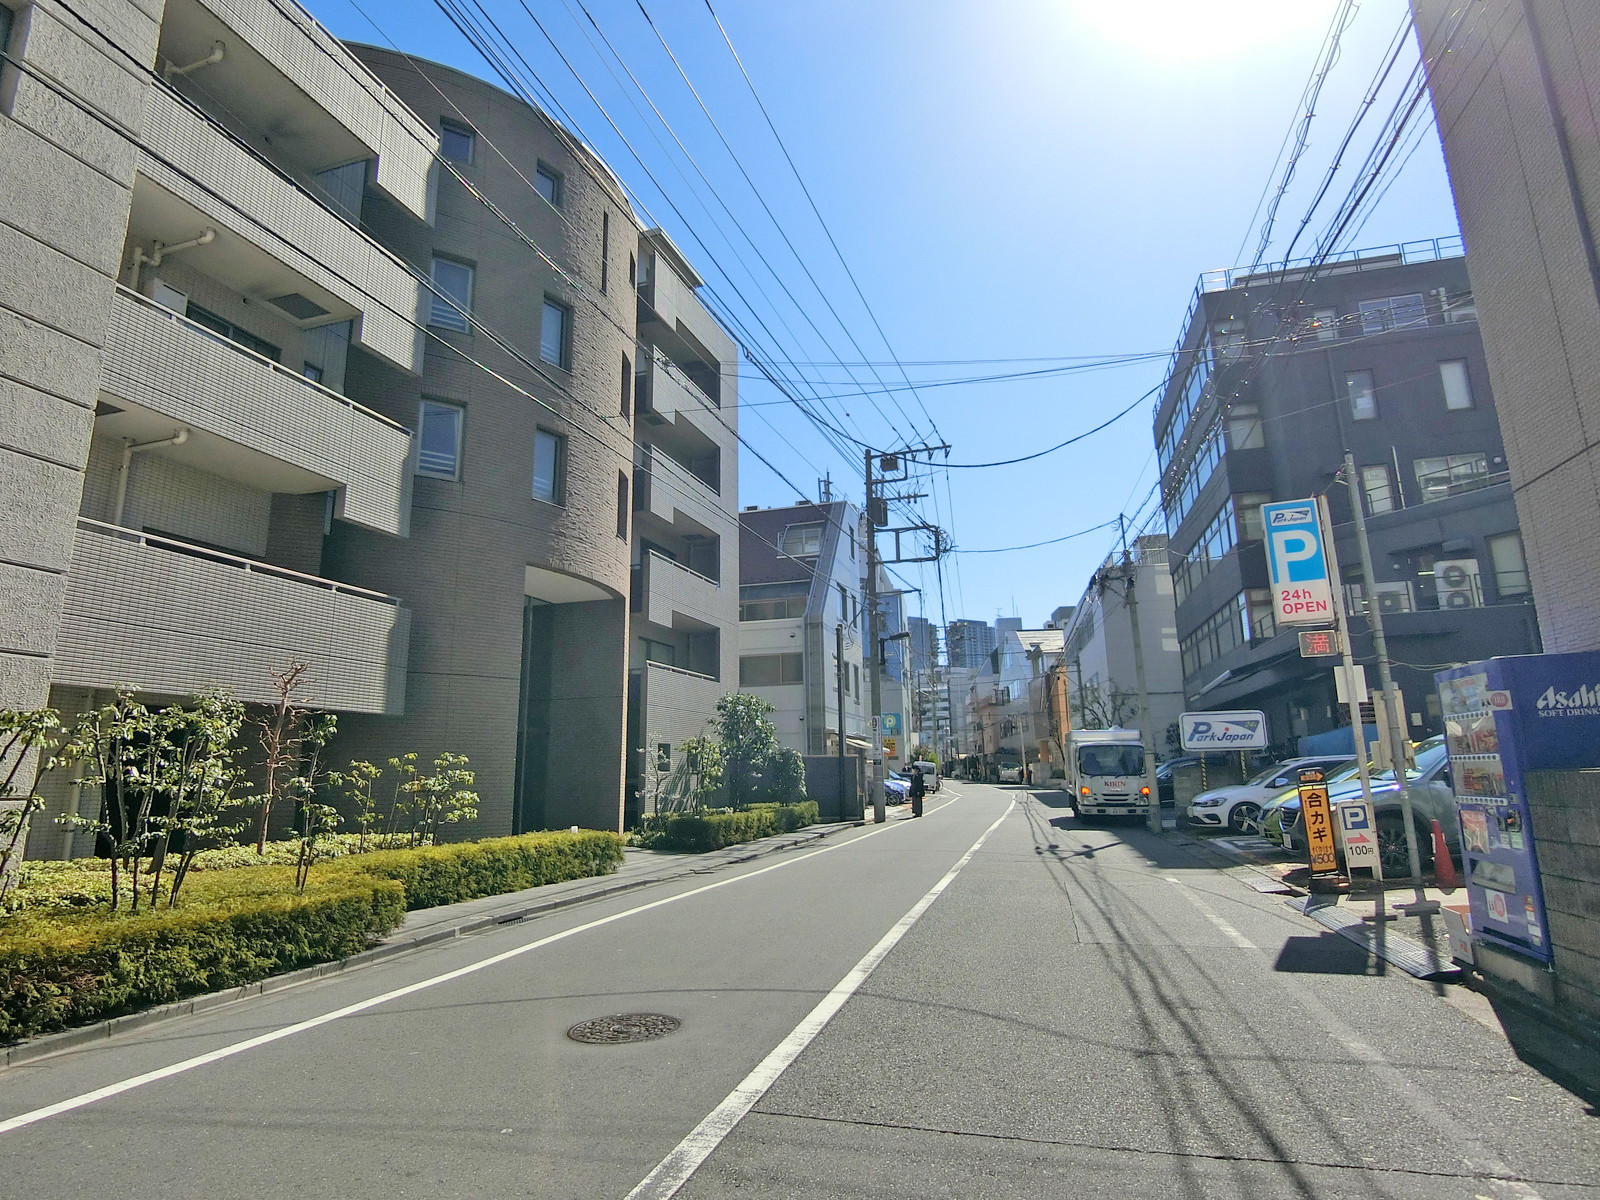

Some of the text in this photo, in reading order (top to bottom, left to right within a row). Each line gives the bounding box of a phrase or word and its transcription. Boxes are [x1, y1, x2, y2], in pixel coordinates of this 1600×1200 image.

[1272, 529, 1317, 583] P
[1281, 588, 1312, 601] 24h
[1282, 600, 1327, 615] OPEN
[1306, 633, 1330, 654] 満
[1538, 707, 1600, 718] SOFT DRINK
[1187, 721, 1254, 743] Park Japan
[1306, 792, 1328, 842] 合カギ
[1344, 807, 1365, 829] P
[1349, 845, 1374, 856] 100円
